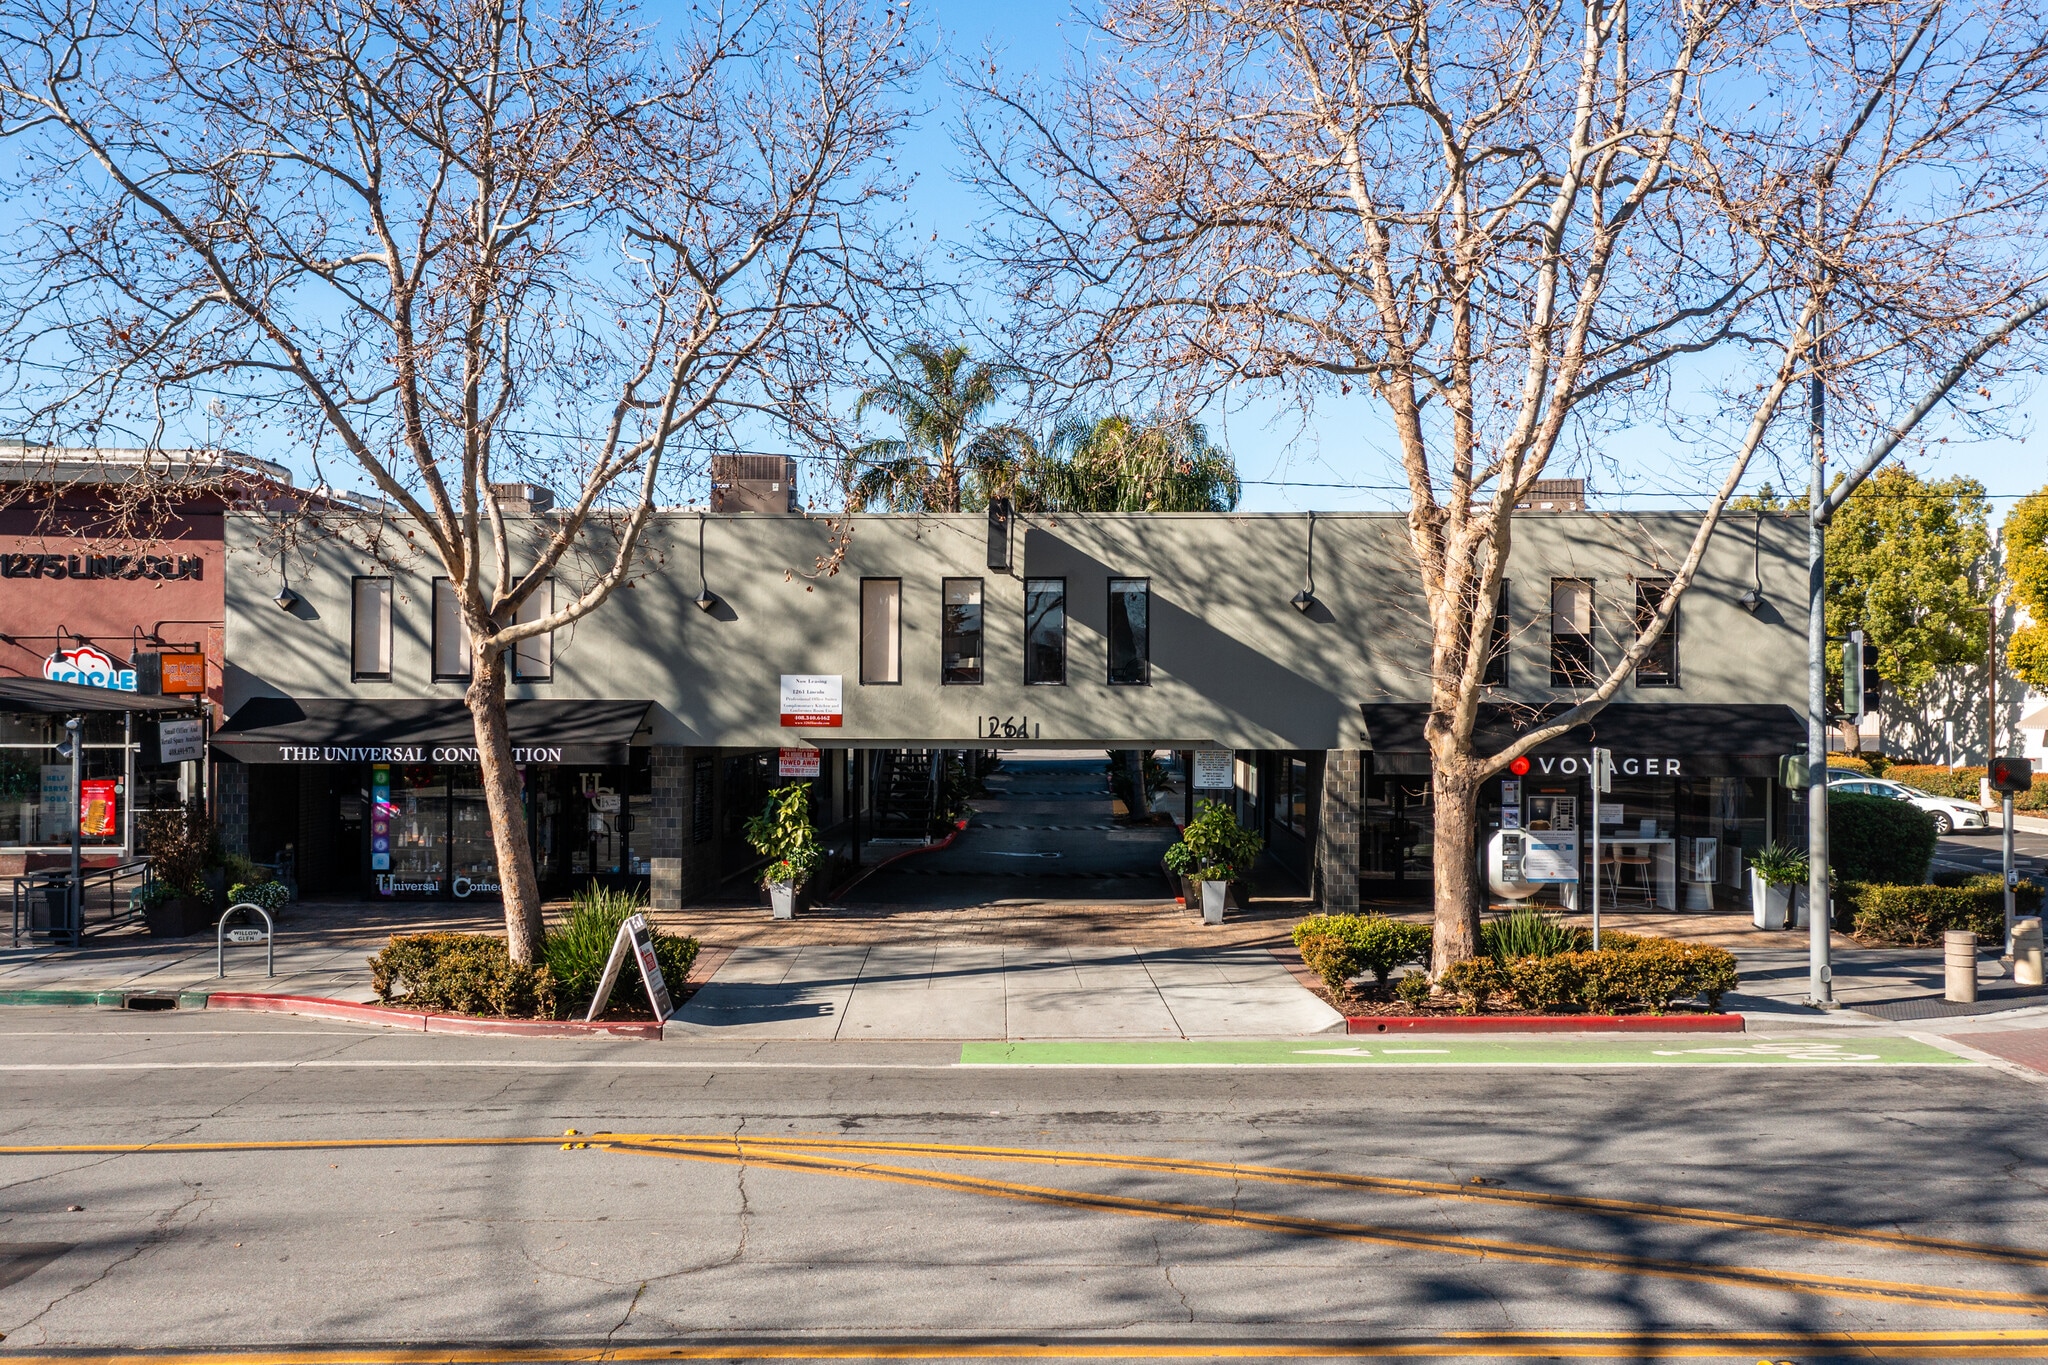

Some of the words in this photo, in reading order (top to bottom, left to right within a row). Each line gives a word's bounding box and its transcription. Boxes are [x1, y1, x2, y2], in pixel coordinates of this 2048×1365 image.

[0, 553, 66, 579] 1275
[68, 554, 203, 580] LINCOLN
[52, 671, 137, 690] ICICLE
[979, 716, 1027, 738] 1261
[279, 747, 319, 761] THE
[324, 747, 427, 761] UNIVERSAL
[432, 747, 562, 762] CONNTION
[1539, 757, 1681, 775] VOYAGER
[377, 874, 439, 895] Universal
[452, 877, 502, 898] Connec
